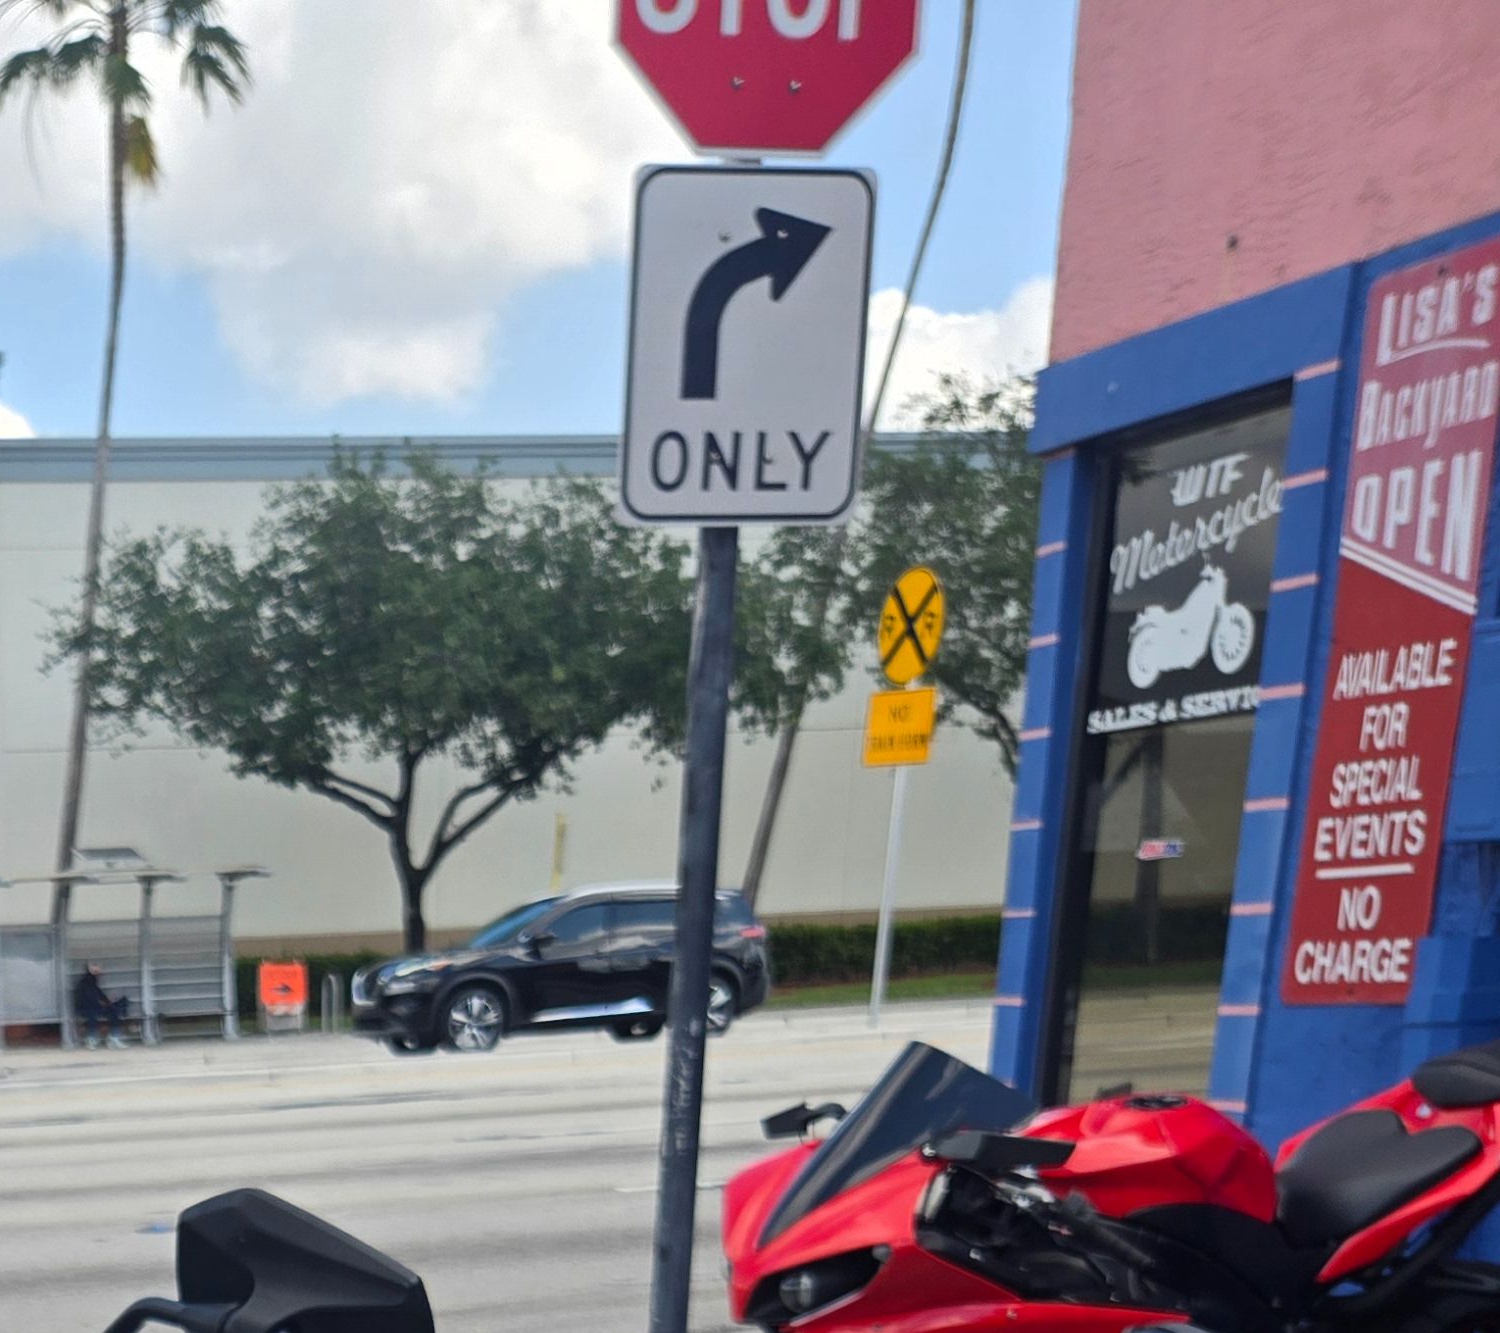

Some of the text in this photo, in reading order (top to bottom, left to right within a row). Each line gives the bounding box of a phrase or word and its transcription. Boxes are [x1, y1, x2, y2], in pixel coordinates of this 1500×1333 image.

[1376, 263, 1499, 366] LISA'S
[650, 429, 831, 493] ONLY
[1170, 452, 1249, 506] WTF
[1351, 449, 1483, 582] OPEN
[1333, 638, 1457, 700] AVAILABLE
[1086, 701, 1159, 735] SALES
[1358, 702, 1410, 752] FOR
[1329, 755, 1423, 809] SPECIAL
[1313, 809, 1428, 862] EVENTS
[1336, 885, 1382, 931] NO
[1294, 937, 1412, 984] CHARGE
